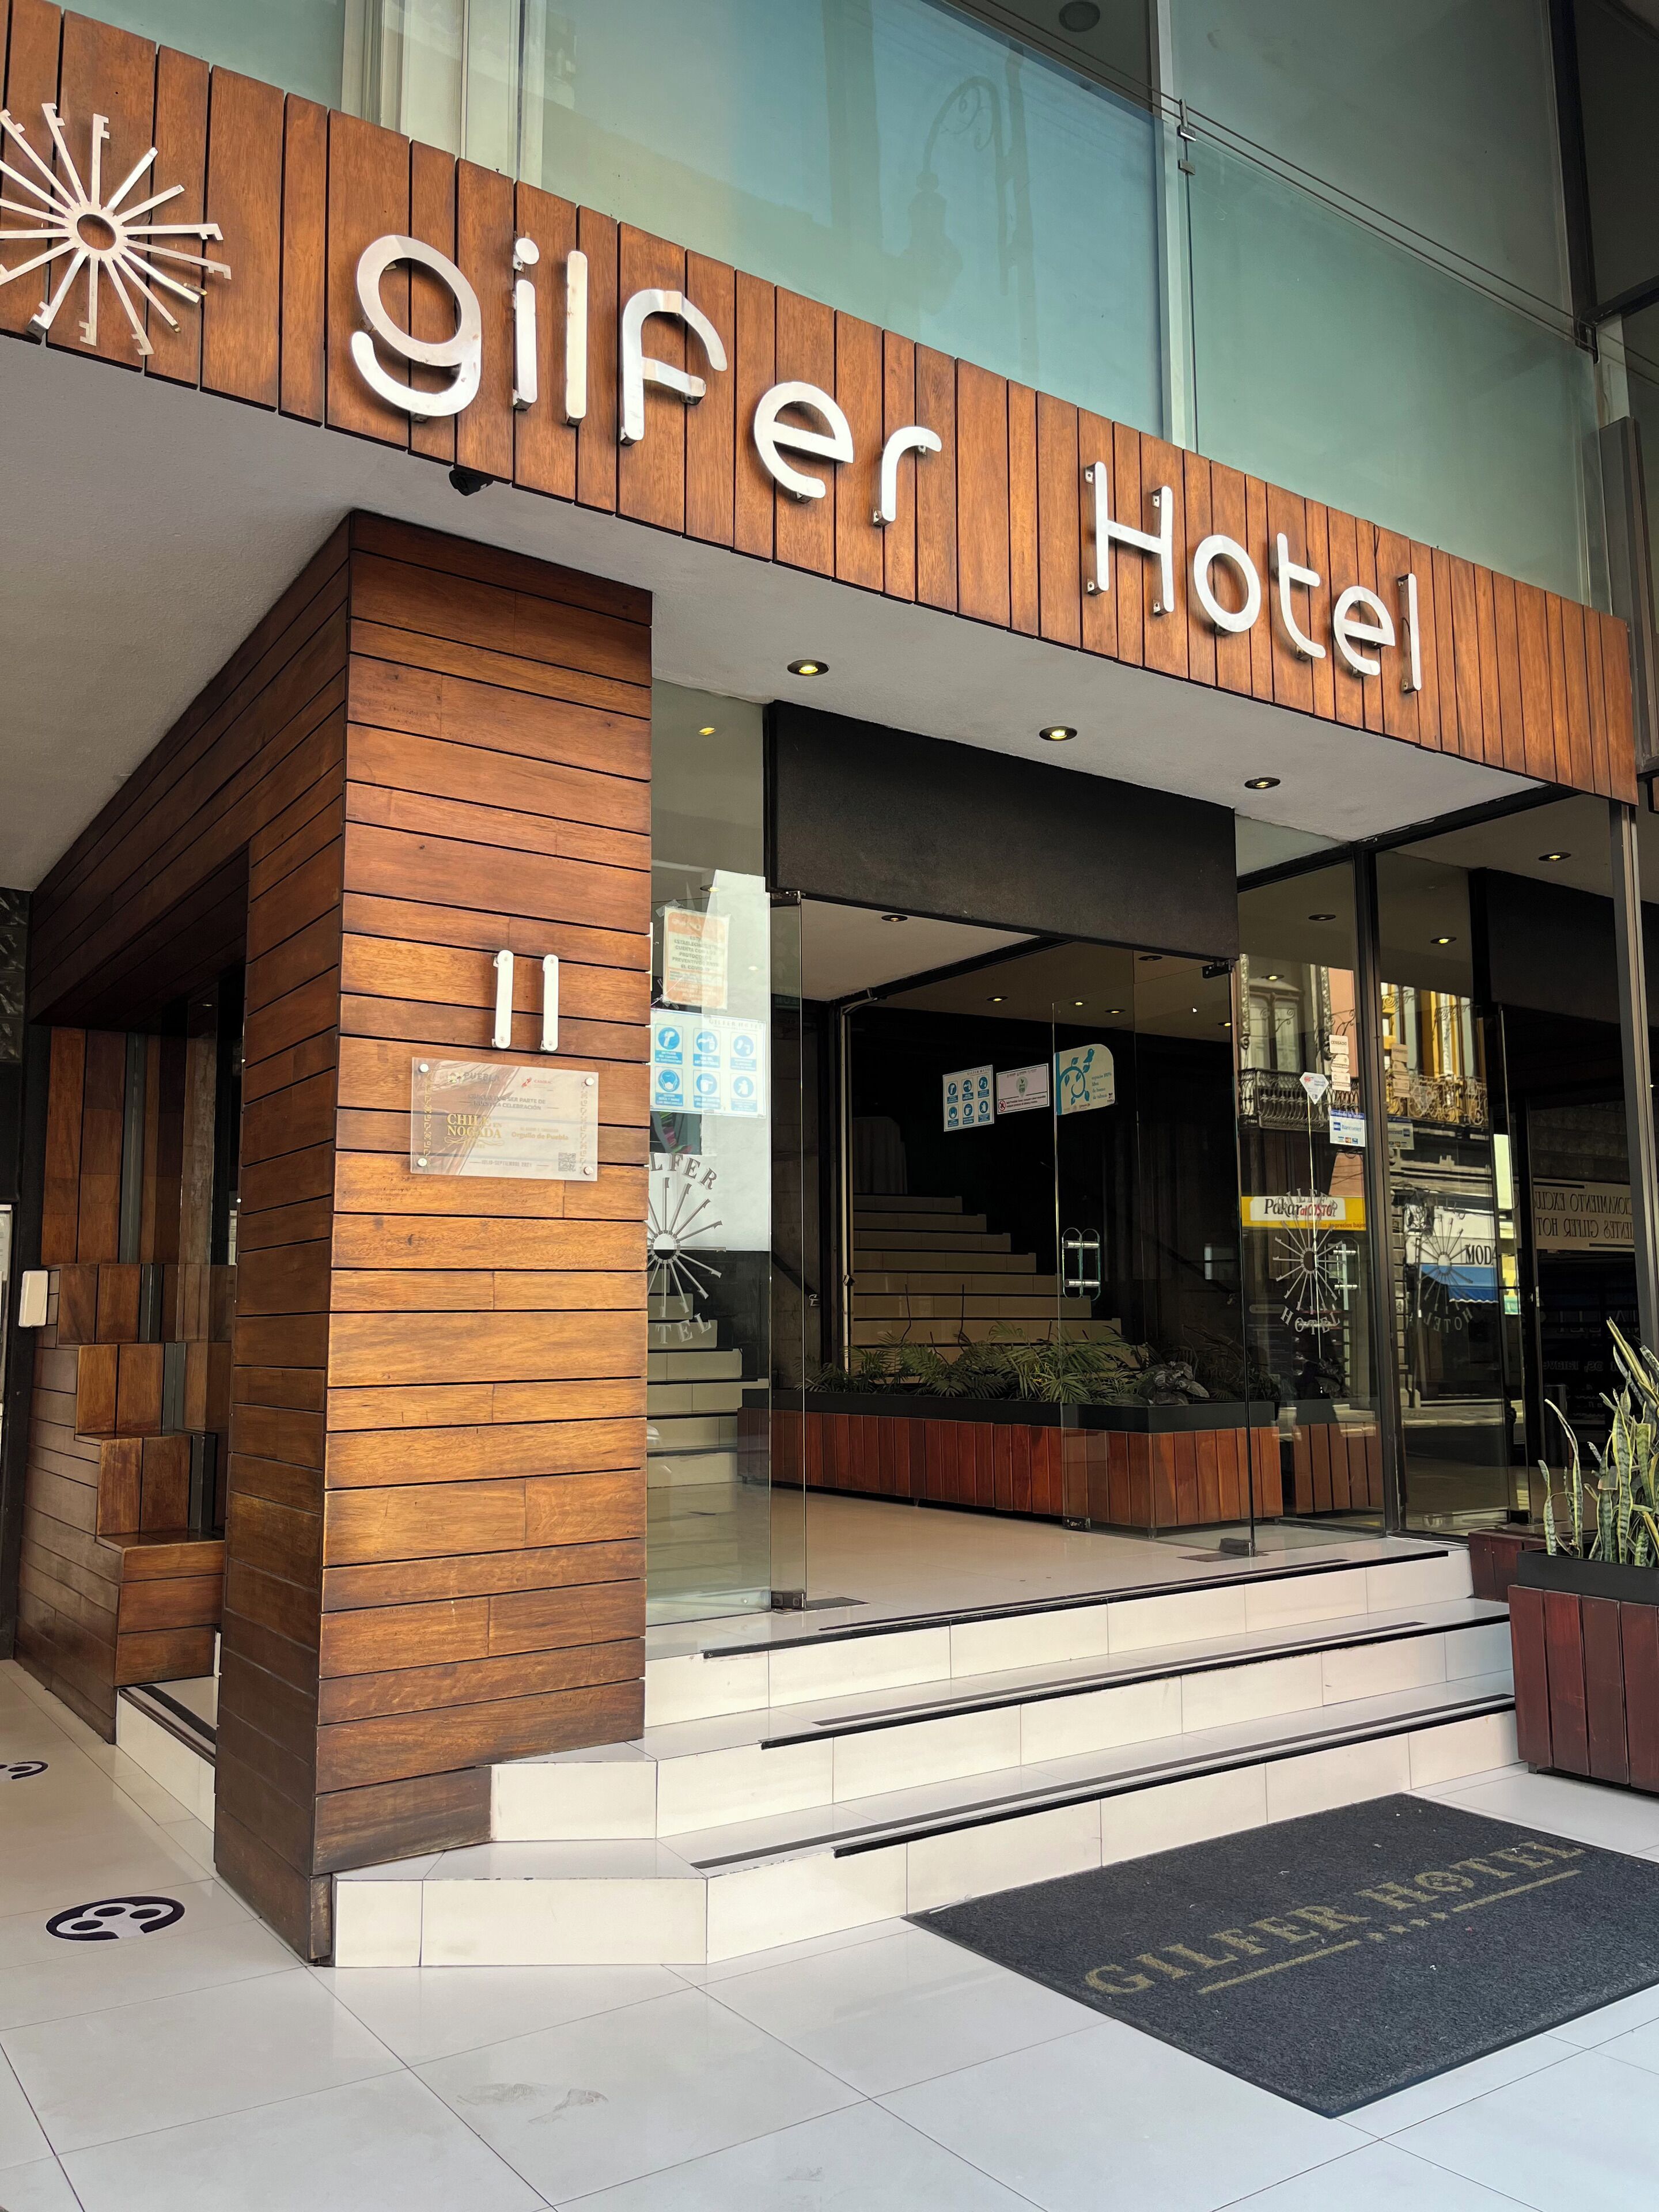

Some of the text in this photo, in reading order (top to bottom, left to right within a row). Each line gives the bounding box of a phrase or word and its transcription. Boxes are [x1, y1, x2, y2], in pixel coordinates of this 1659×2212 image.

[1086, 461, 1422, 692] Hotel
[446, 1113, 491, 1127] CHILE
[446, 1124, 502, 1139] NOGADA
[511, 1131, 536, 1140] Orgullo
[649, 1152, 718, 1190] LFER
[655, 1313, 712, 1344] TEL
[1084, 1840, 1585, 1994] GILFER HOTEL
